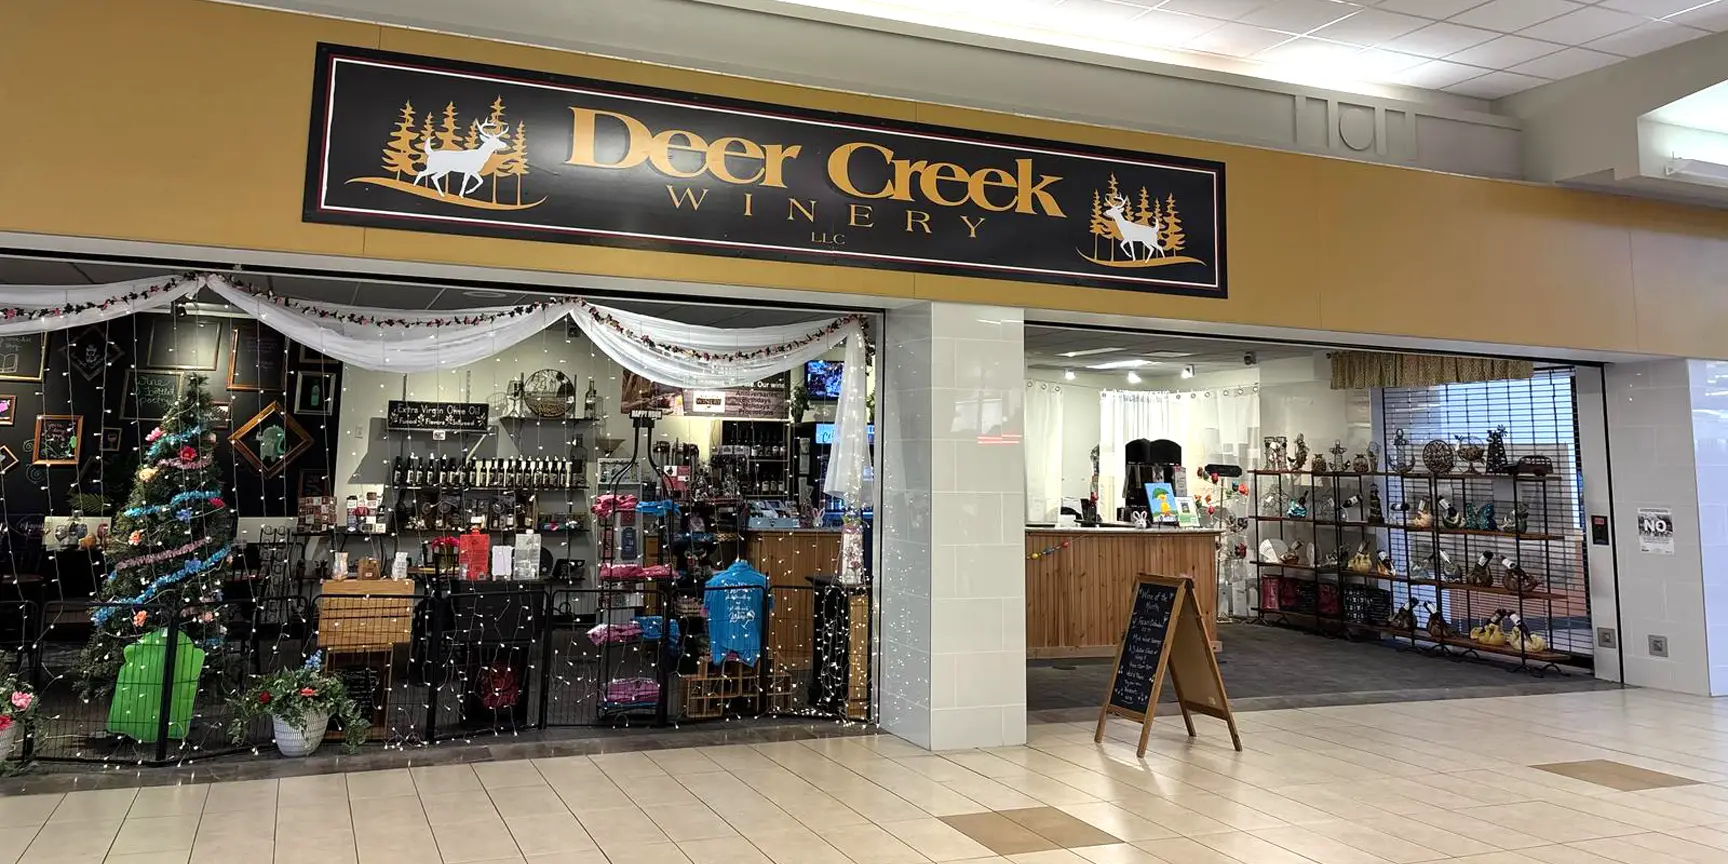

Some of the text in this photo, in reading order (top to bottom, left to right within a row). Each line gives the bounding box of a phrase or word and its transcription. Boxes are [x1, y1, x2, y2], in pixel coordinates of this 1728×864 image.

[564, 106, 1068, 219] Deer Creek
[666, 184, 986, 239] WINERY
[811, 231, 846, 245] LLC
[757, 380, 770, 388] Our
[397, 403, 481, 417] Extra Virgin Olive Oil
[1644, 519, 1666, 532] NO
